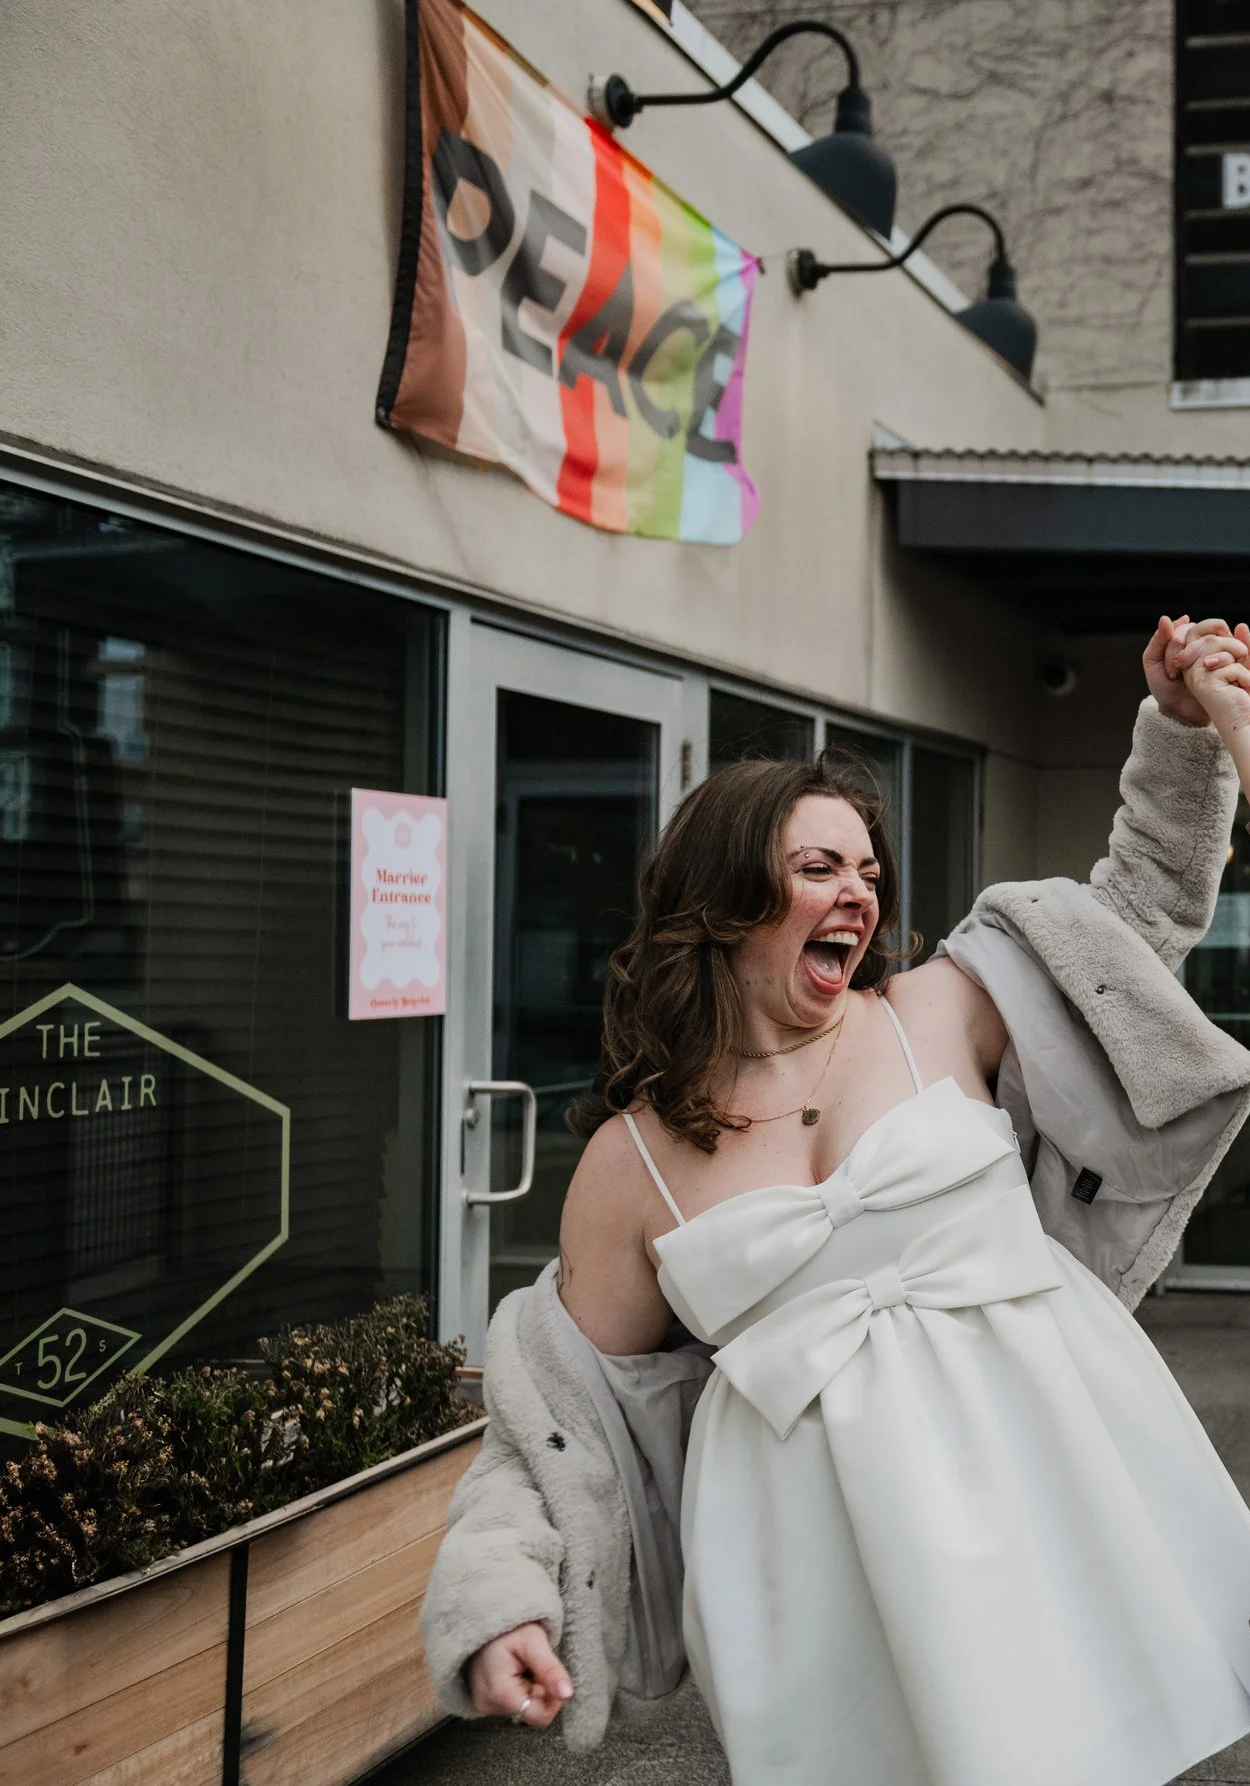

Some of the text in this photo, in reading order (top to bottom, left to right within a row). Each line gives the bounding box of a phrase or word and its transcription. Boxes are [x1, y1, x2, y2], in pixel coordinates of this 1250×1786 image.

[372, 887, 431, 905] Entrance
[376, 868, 427, 886] Marrier
[35, 1021, 102, 1060] THE
[0, 1073, 157, 1125] INCLAIR
[37, 1328, 87, 1390] 52
[98, 1339, 107, 1353] S
